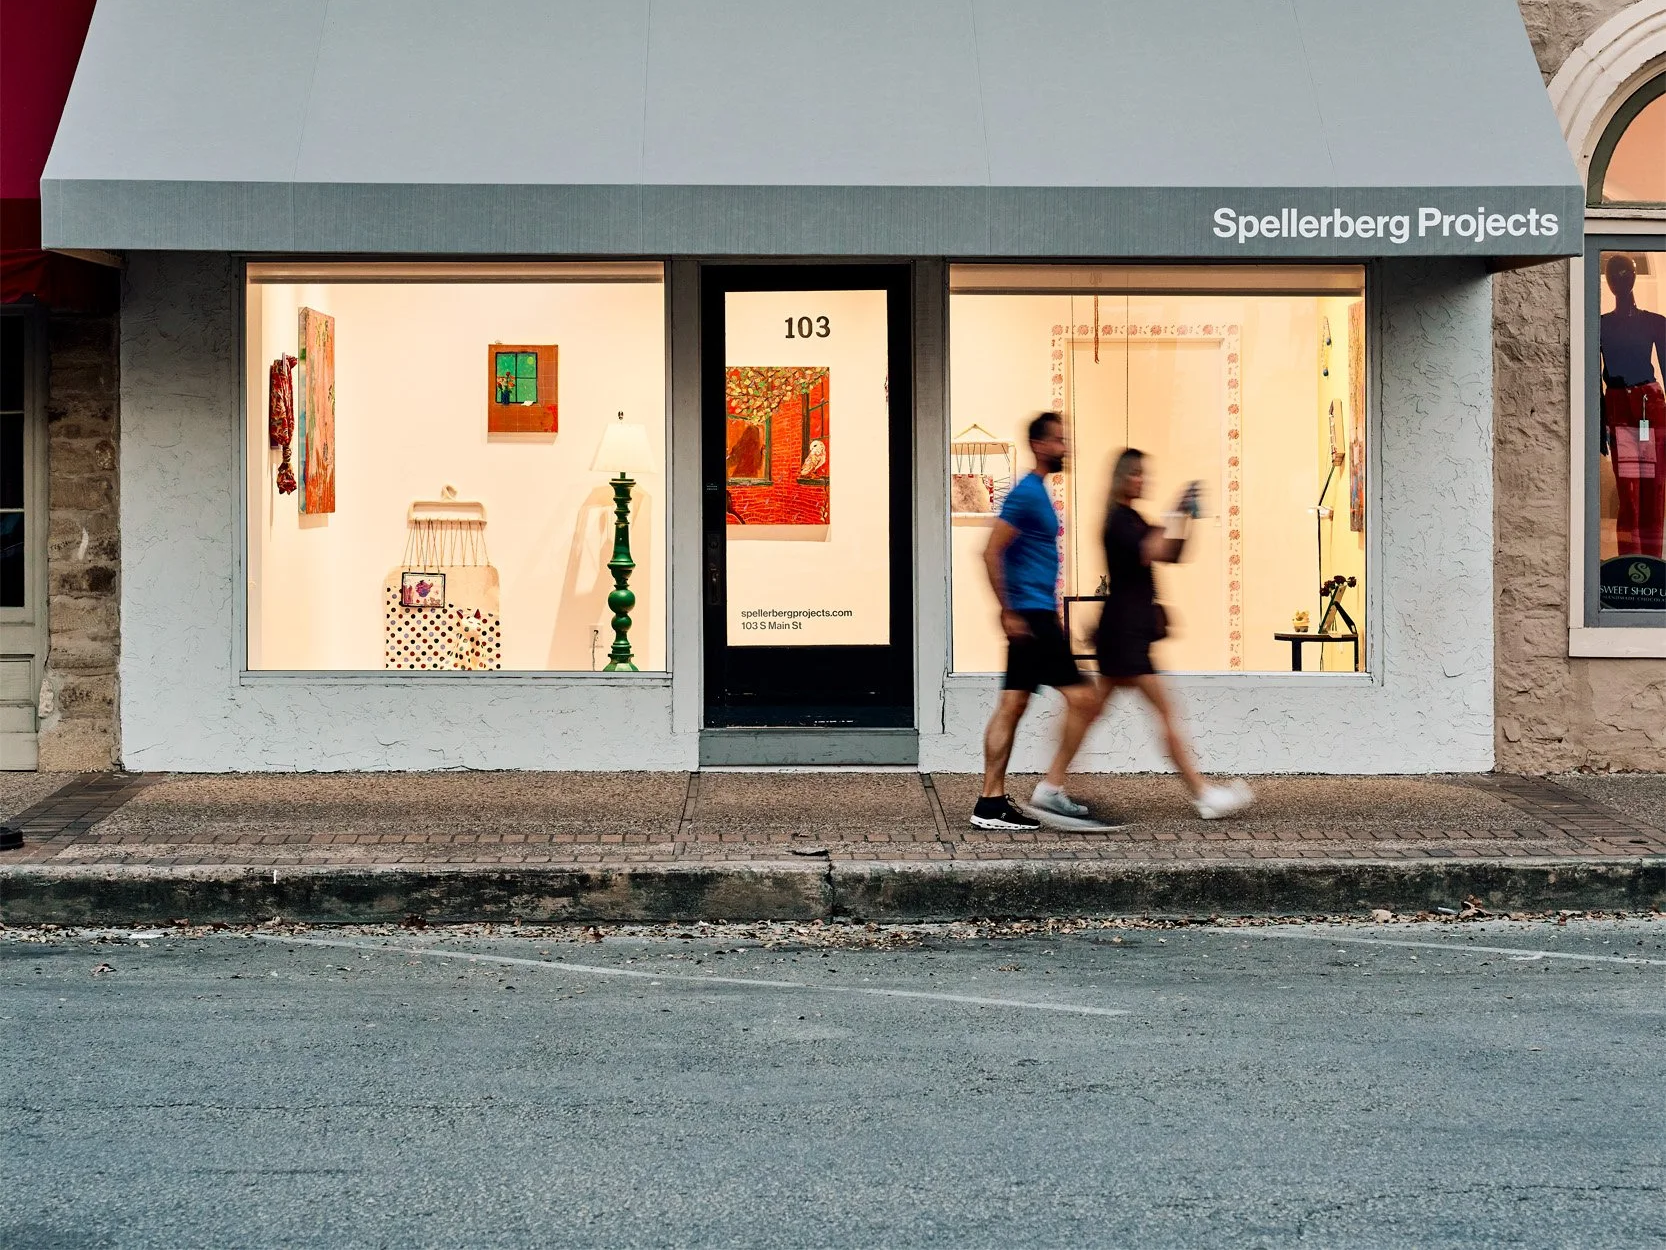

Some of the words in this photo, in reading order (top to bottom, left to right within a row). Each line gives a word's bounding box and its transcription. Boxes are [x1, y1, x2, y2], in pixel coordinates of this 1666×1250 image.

[1213, 207, 1410, 244] Spellerberg
[1418, 206, 1559, 242] Projects
[785, 315, 831, 338] 103
[1600, 585, 1629, 595] SWEET
[1631, 586, 1658, 596] SHOP
[741, 609, 853, 619] spellerbergprojects.com
[741, 621, 758, 630] 103
[760, 621, 767, 630] S
[768, 621, 790, 630] Main
[792, 621, 802, 630] St
